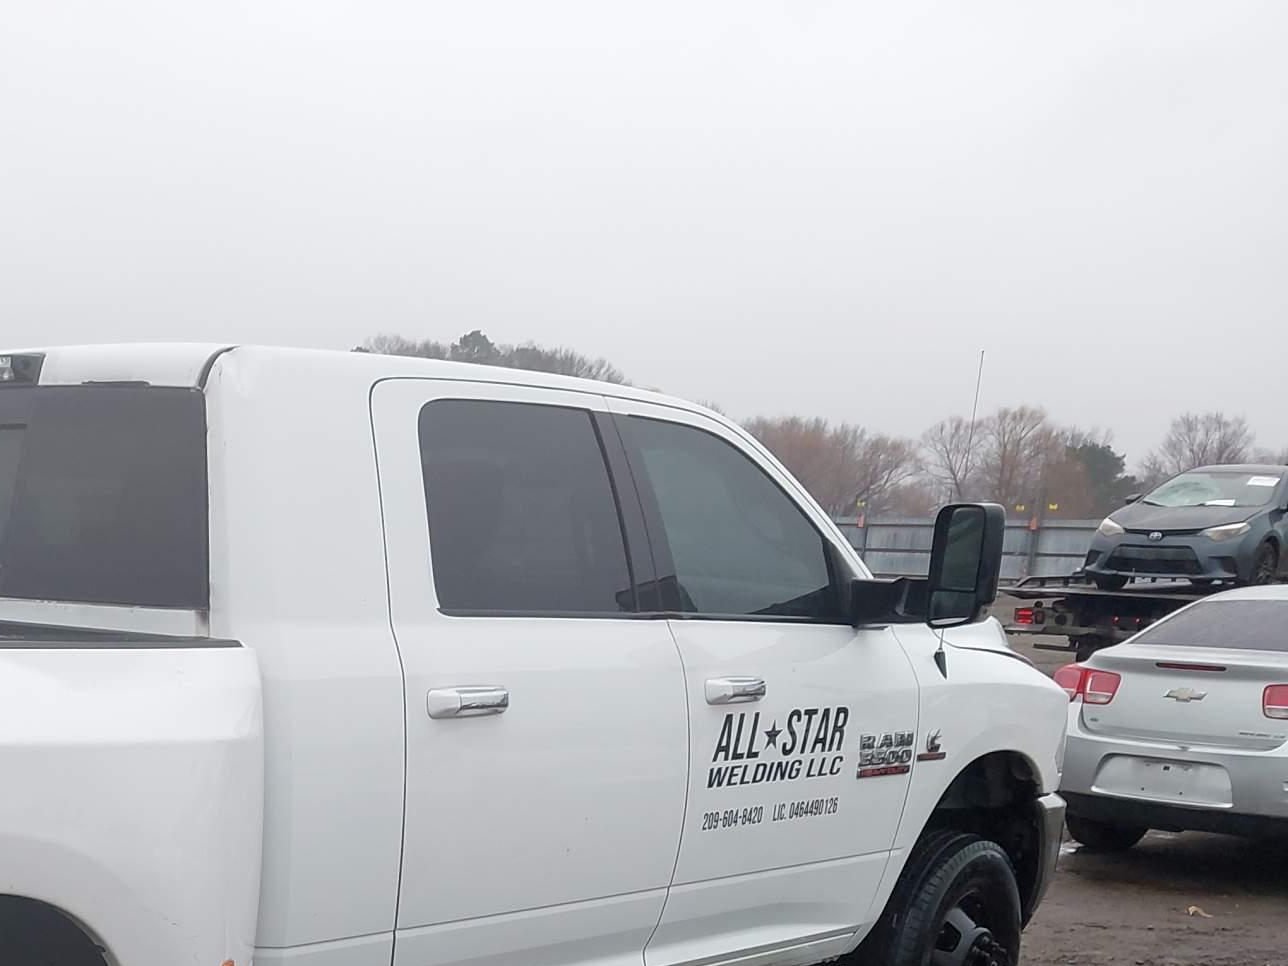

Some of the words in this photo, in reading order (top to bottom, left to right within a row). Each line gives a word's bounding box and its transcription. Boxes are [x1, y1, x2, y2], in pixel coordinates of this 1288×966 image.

[712, 711, 760, 762] ALL
[781, 706, 849, 756] STAR
[859, 732, 914, 750] RAM
[706, 759, 803, 789] WELDING
[806, 755, 844, 778] LLC
[702, 805, 763, 831] 209-604-8420
[772, 803, 787, 821] LIC.
